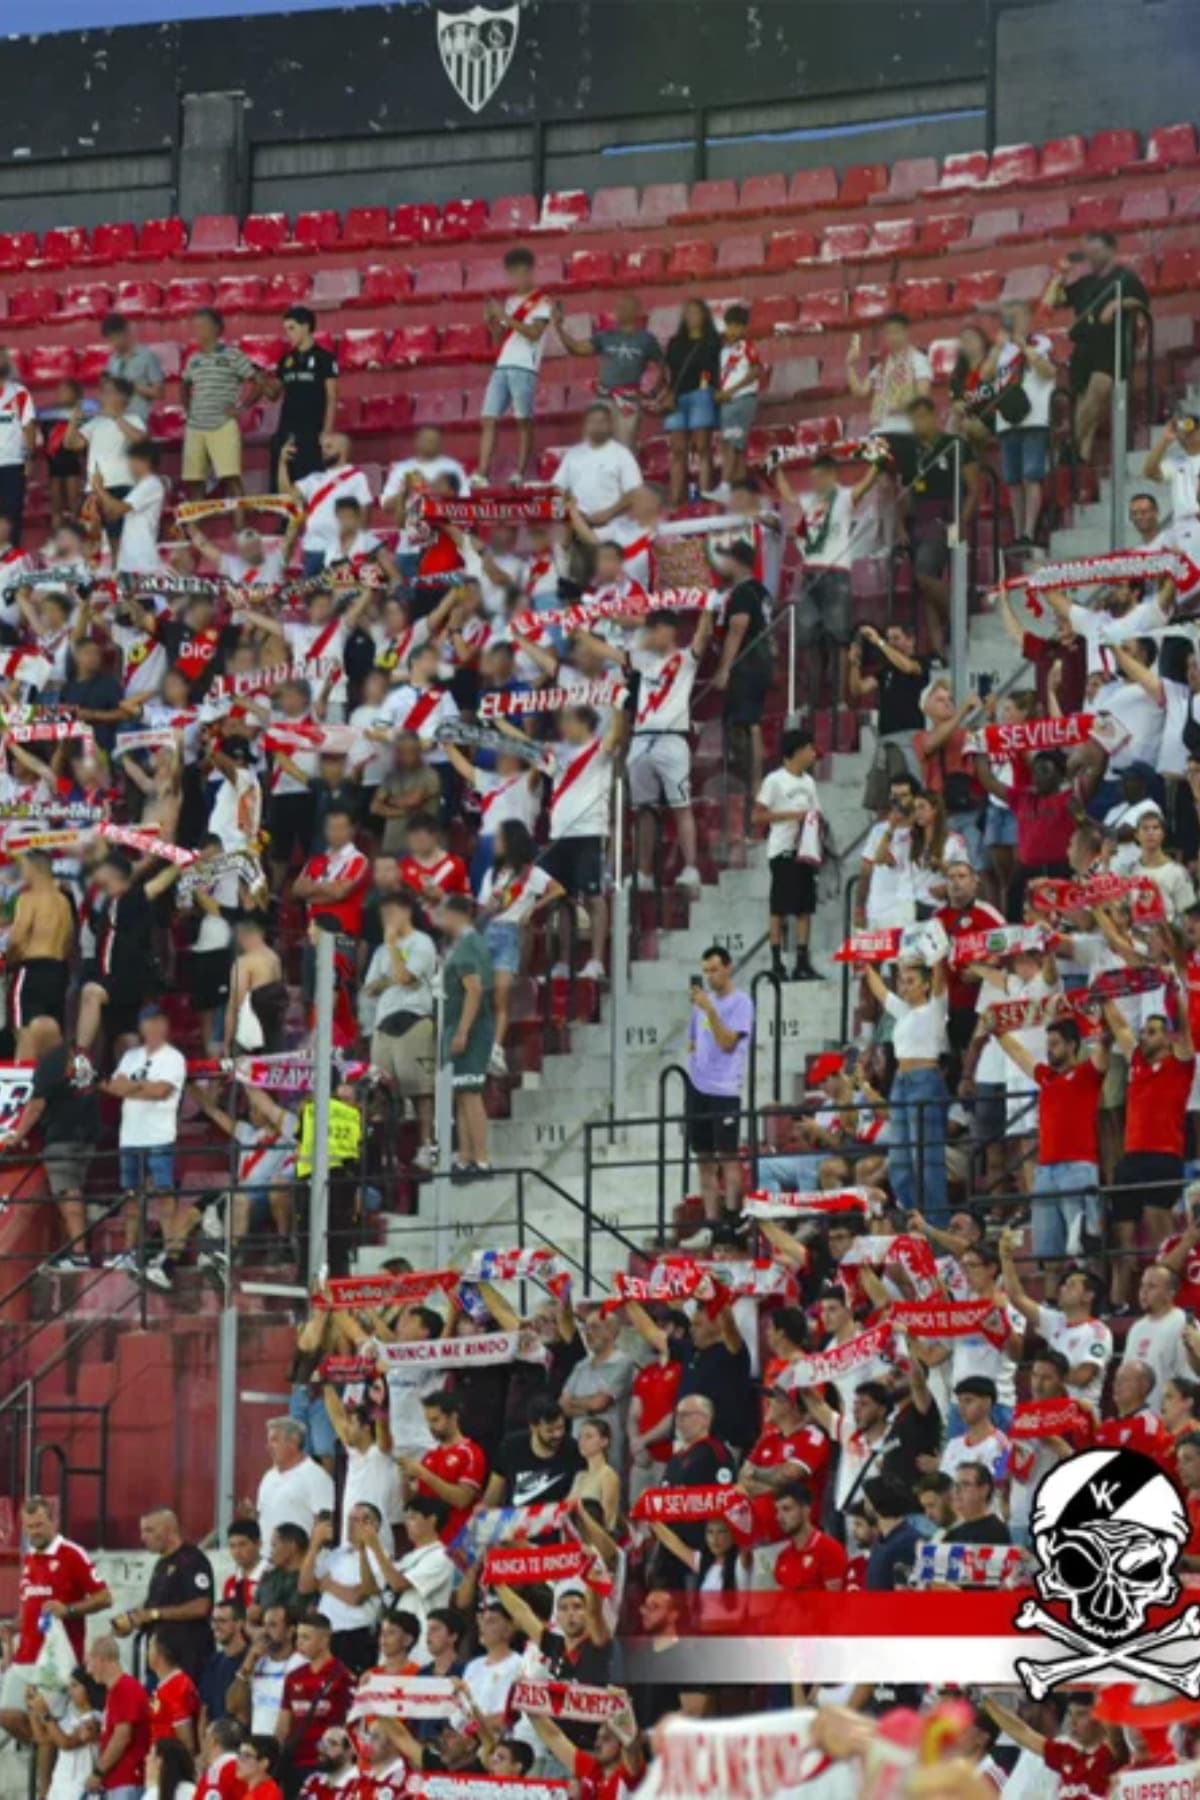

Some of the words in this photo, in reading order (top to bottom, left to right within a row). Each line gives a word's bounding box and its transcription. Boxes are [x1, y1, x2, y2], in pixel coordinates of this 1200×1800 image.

[998, 717, 1081, 749] SEVILLA
[386, 1341, 438, 1361] NUNCA
[441, 1340, 463, 1359] ME
[465, 1337, 509, 1357] RINDO
[490, 1556, 527, 1575] NUNCA
[528, 1556, 540, 1572] TE
